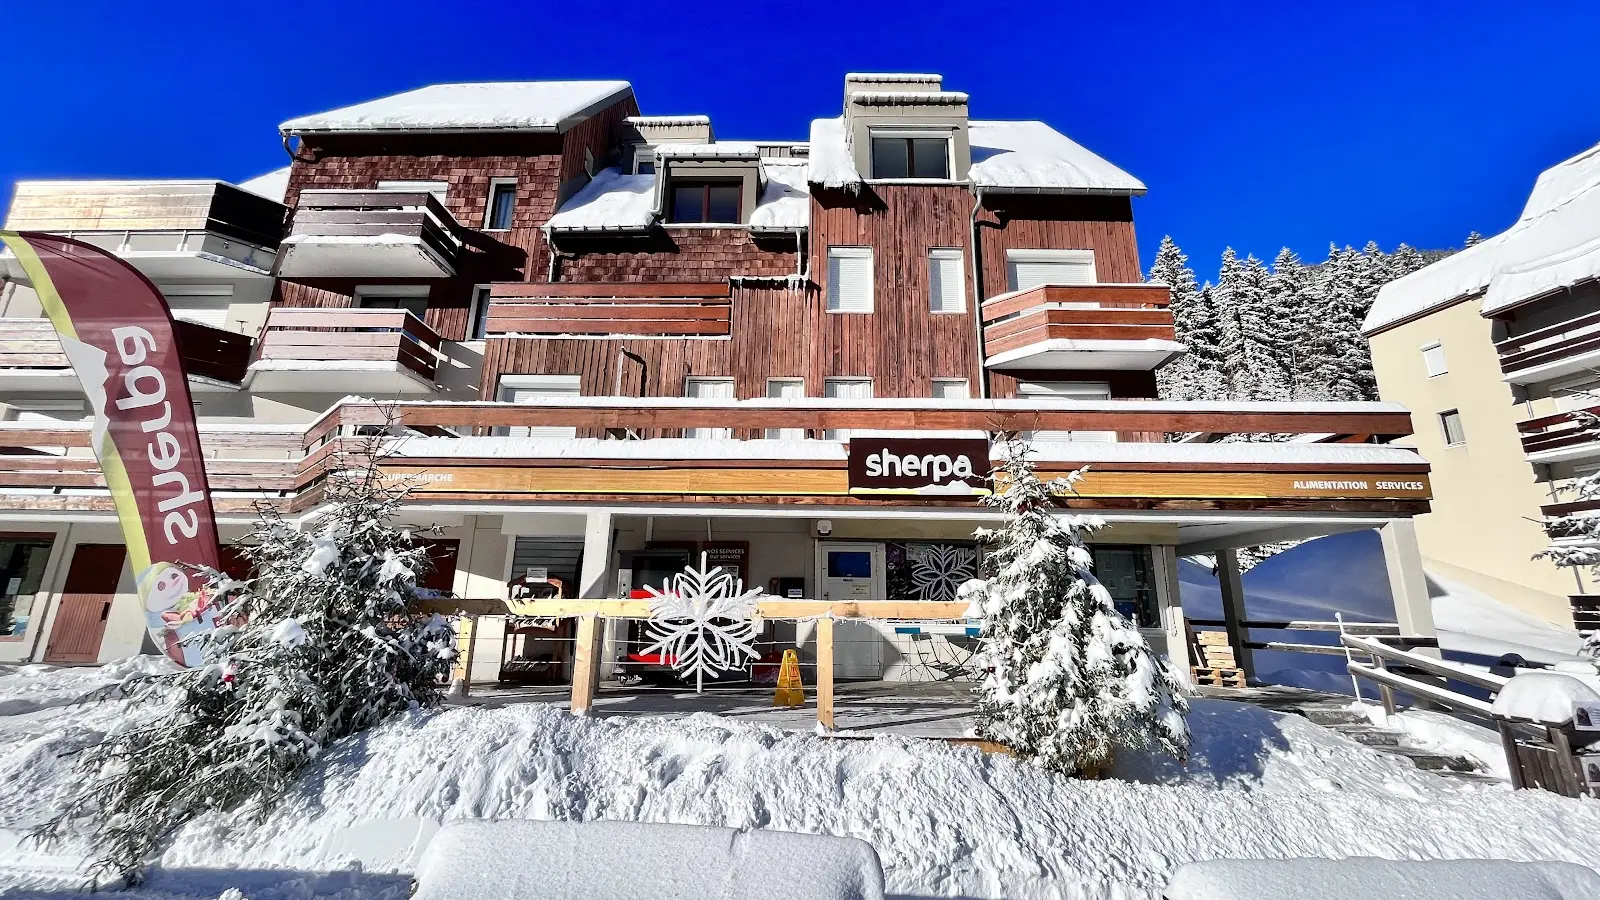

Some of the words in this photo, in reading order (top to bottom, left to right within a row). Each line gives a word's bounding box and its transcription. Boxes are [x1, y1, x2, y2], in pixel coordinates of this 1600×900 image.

[865, 447, 972, 482] sherpa
[1293, 480, 1368, 490] ALIMENTATION
[1375, 481, 1424, 490] SERVICES
